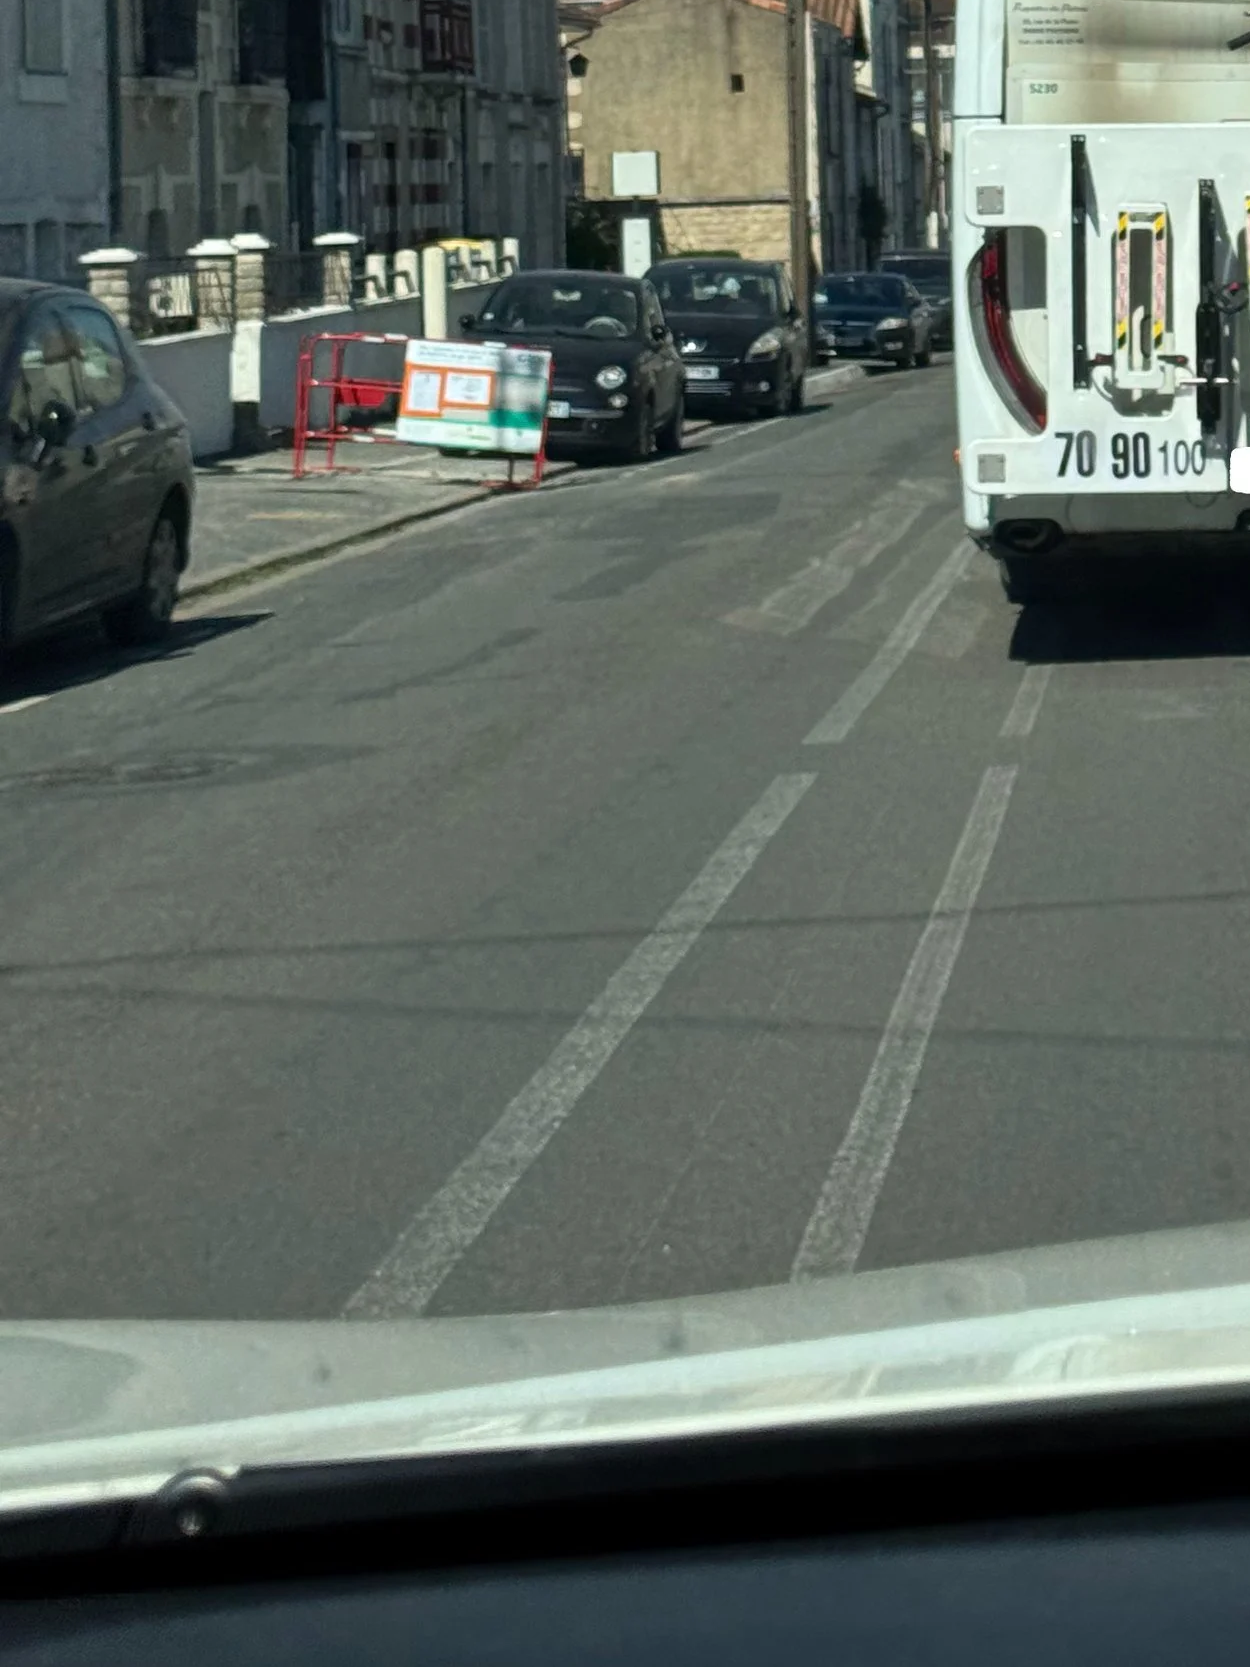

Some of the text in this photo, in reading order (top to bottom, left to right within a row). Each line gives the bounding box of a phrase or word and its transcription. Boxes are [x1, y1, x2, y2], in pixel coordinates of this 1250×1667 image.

[1054, 430, 1206, 479] 70 90 100
